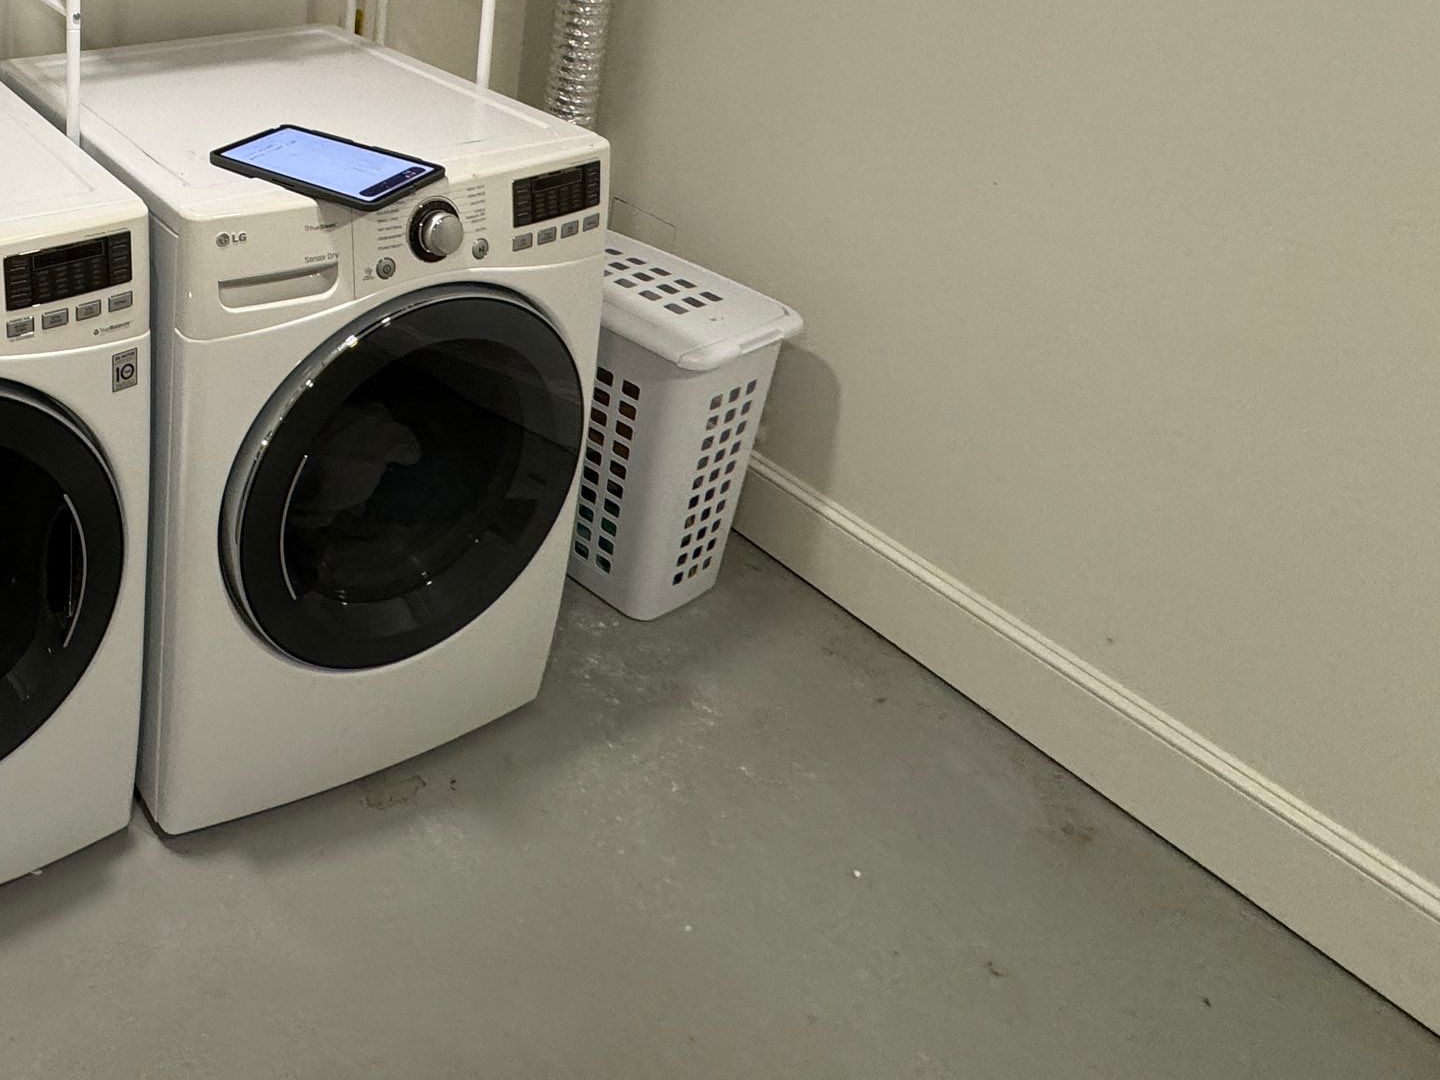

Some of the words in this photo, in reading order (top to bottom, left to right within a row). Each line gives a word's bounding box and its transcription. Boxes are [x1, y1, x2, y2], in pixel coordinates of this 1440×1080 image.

[232, 232, 247, 243] LG
[304, 255, 326, 264] Sensor
[327, 252, 339, 260] Dry
